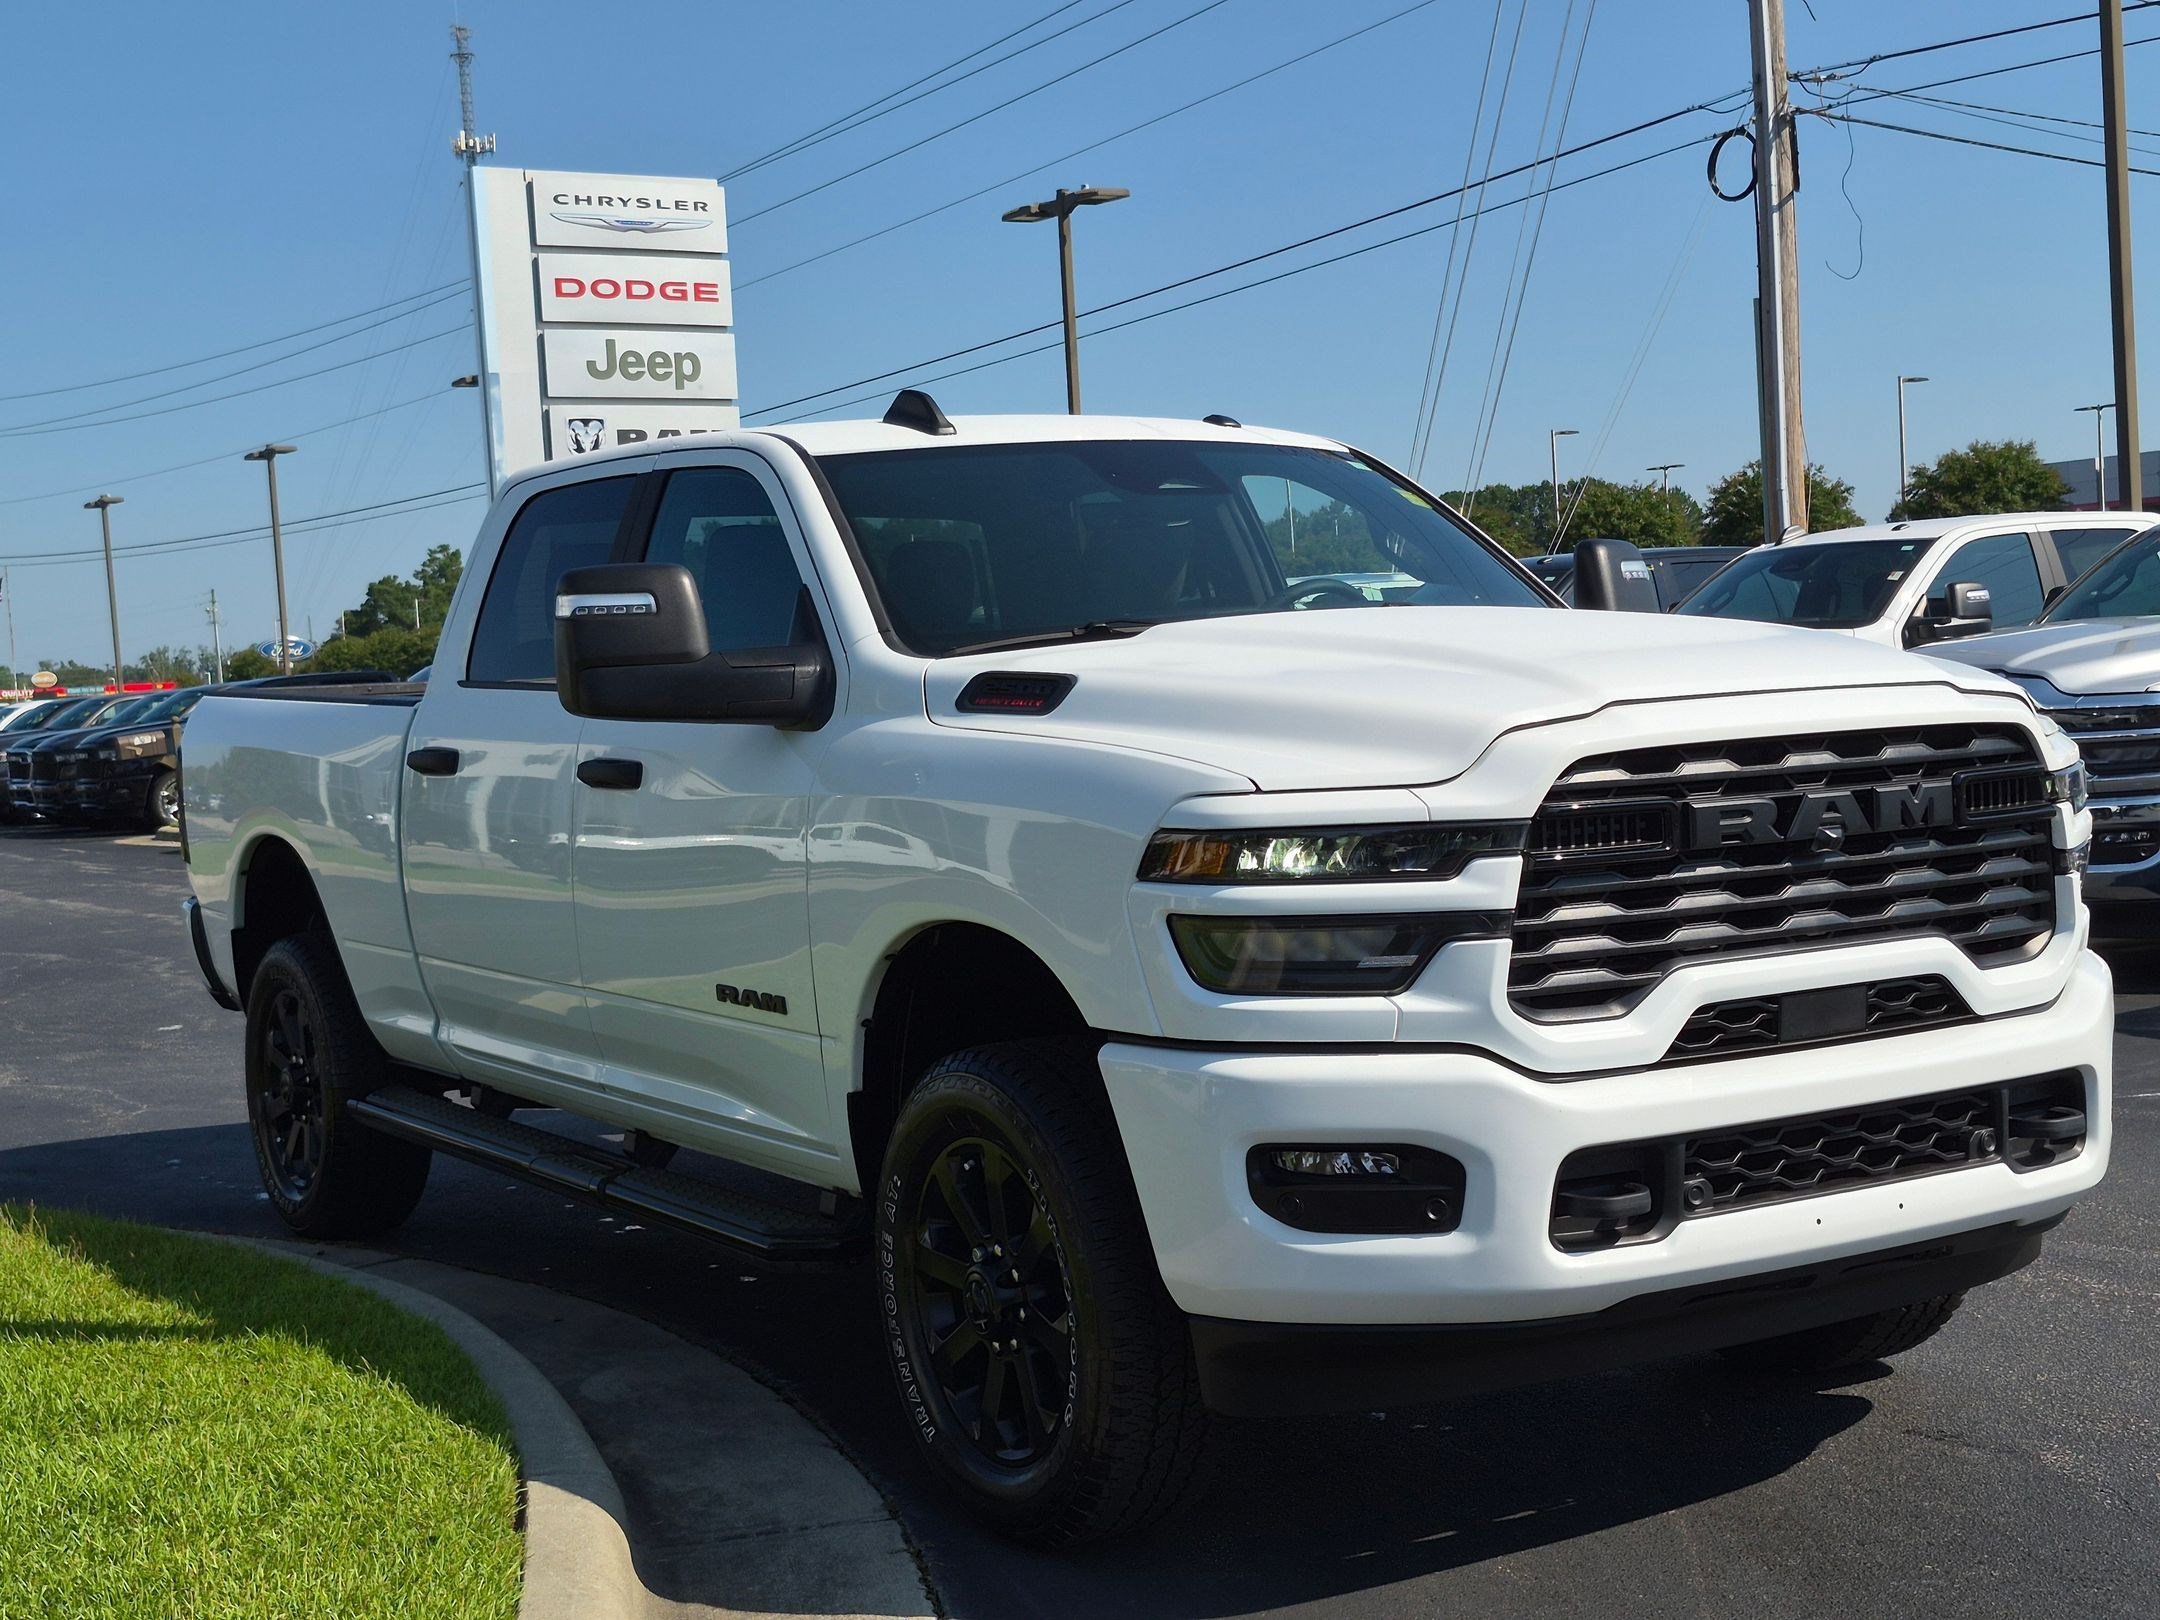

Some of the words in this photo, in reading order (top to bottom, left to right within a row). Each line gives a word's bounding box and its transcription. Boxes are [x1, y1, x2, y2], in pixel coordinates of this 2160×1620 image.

[553, 193, 709, 213] CHRYSLER
[554, 277, 720, 303] DODGE
[586, 338, 702, 390] Jeep
[1, 689, 35, 698] QUALITY
[1011, 697, 1046, 708] DUTY
[1689, 777, 1954, 849] RAM
[716, 983, 788, 1016] RAM
[881, 1231, 936, 1444] TRANSFORCE
